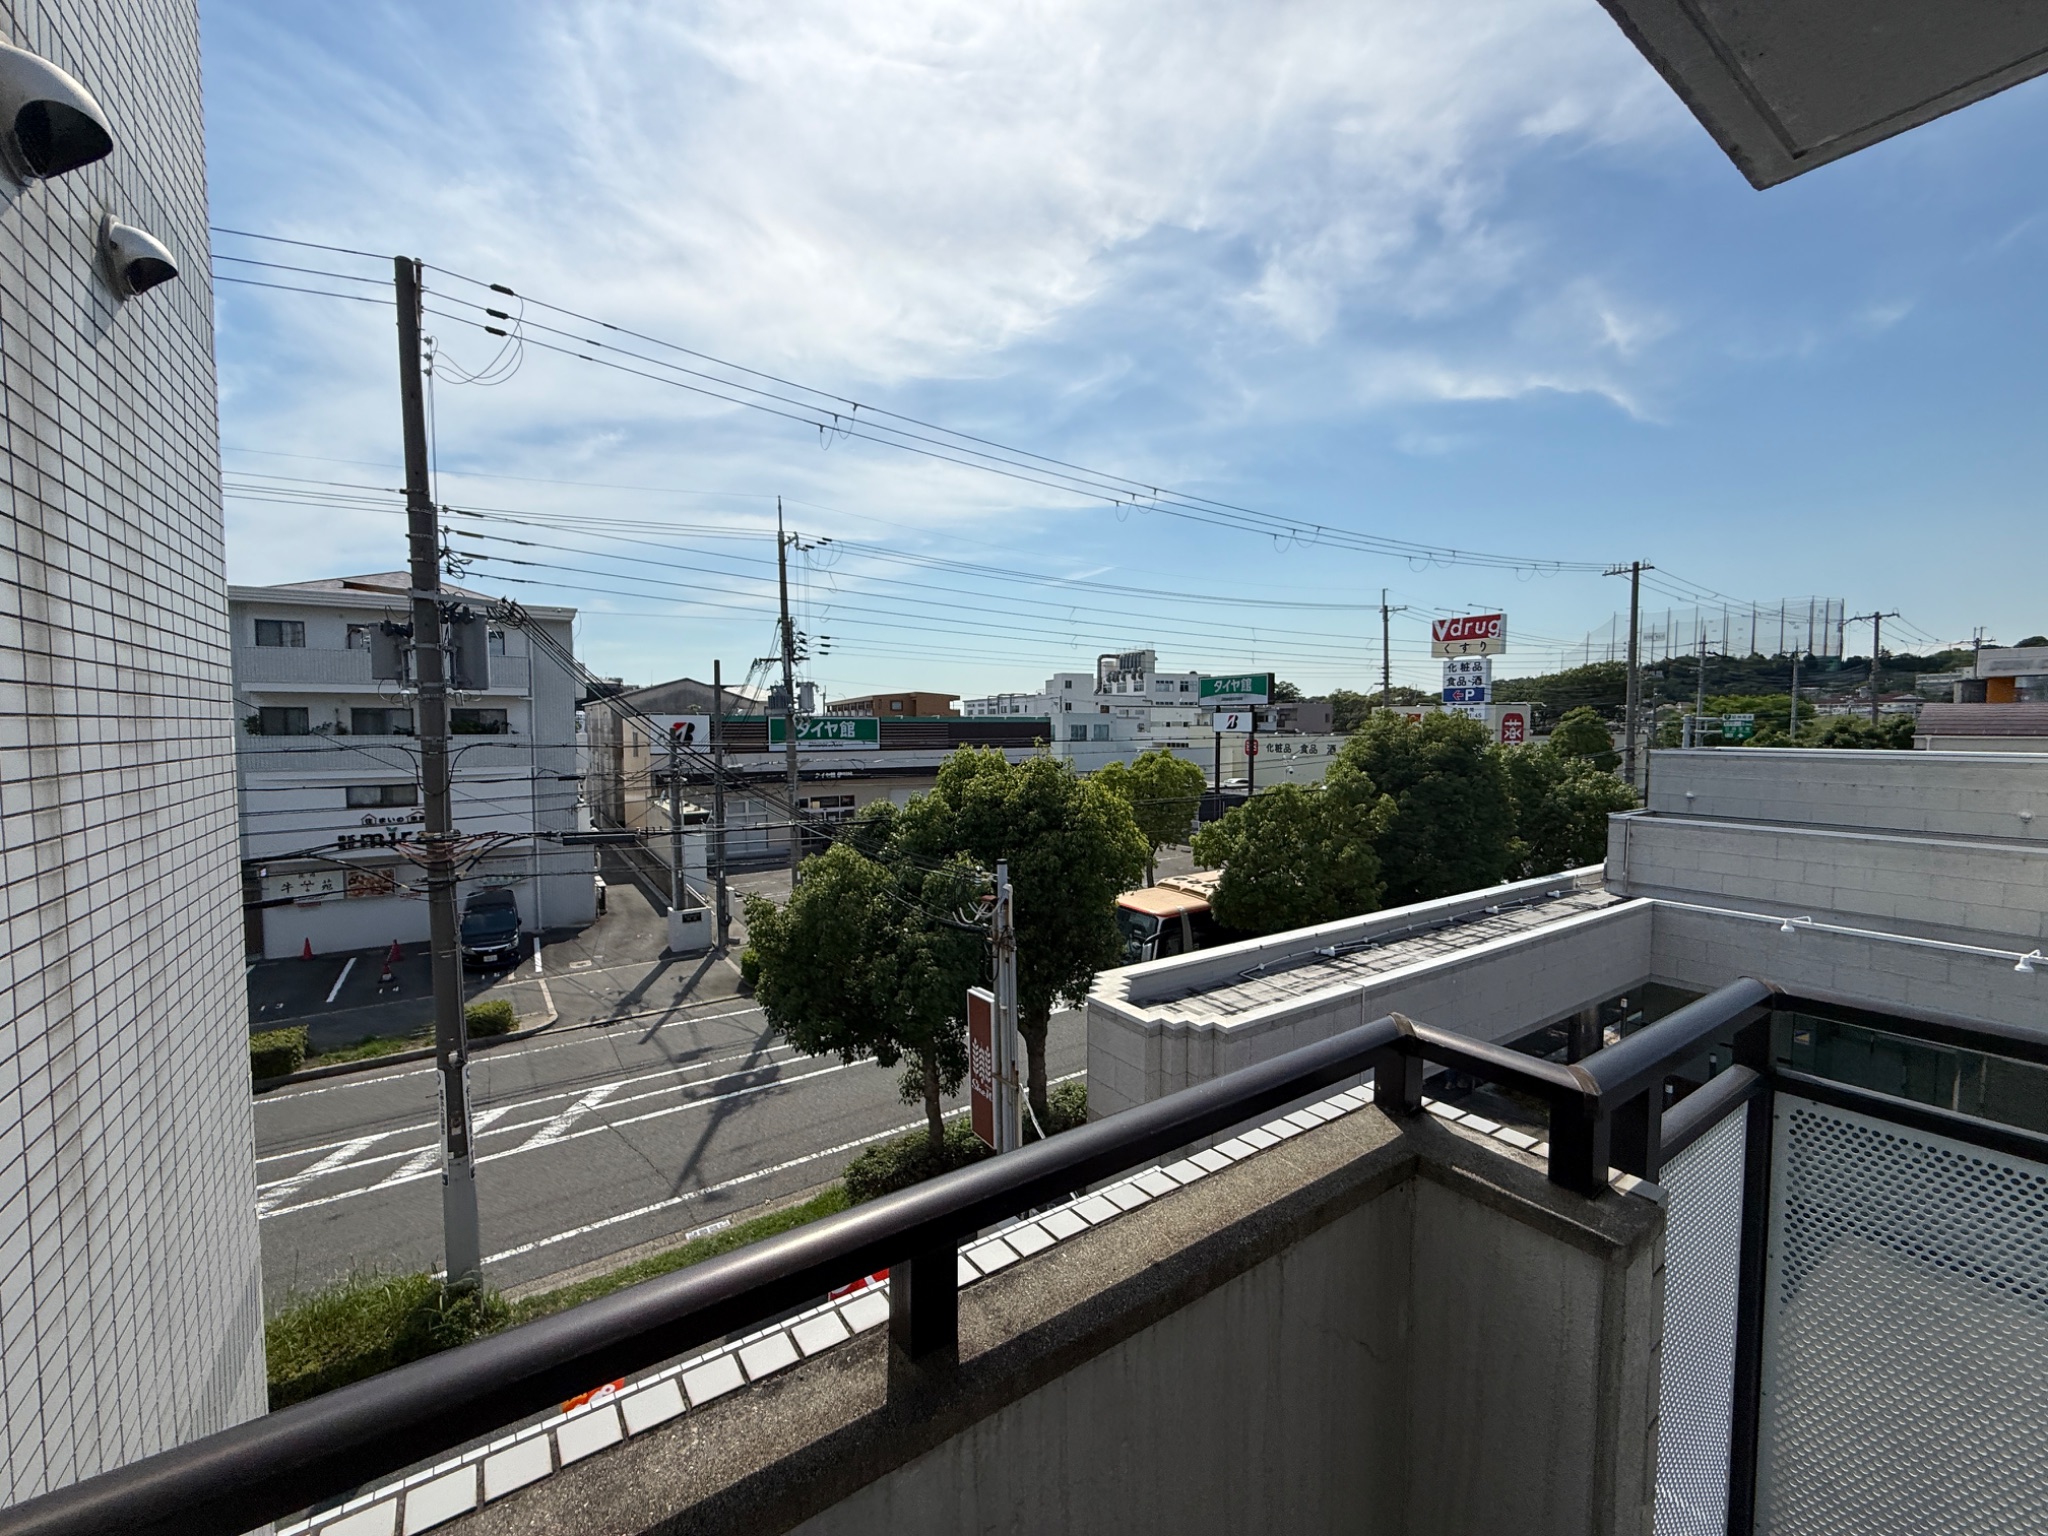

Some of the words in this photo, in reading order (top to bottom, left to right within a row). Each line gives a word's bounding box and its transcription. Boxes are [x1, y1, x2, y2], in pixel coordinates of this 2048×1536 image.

[1444, 641, 1487, 654] くすり
[1447, 661, 1483, 673] 化粧品
[1213, 678, 1253, 693] タイヤ館
[1465, 689, 1475, 701] P
[797, 721, 856, 739] タイヤ館
[1266, 743, 1292, 753] 化粧品
[1300, 744, 1318, 755] 食品
[1326, 744, 1337, 756] 酒
